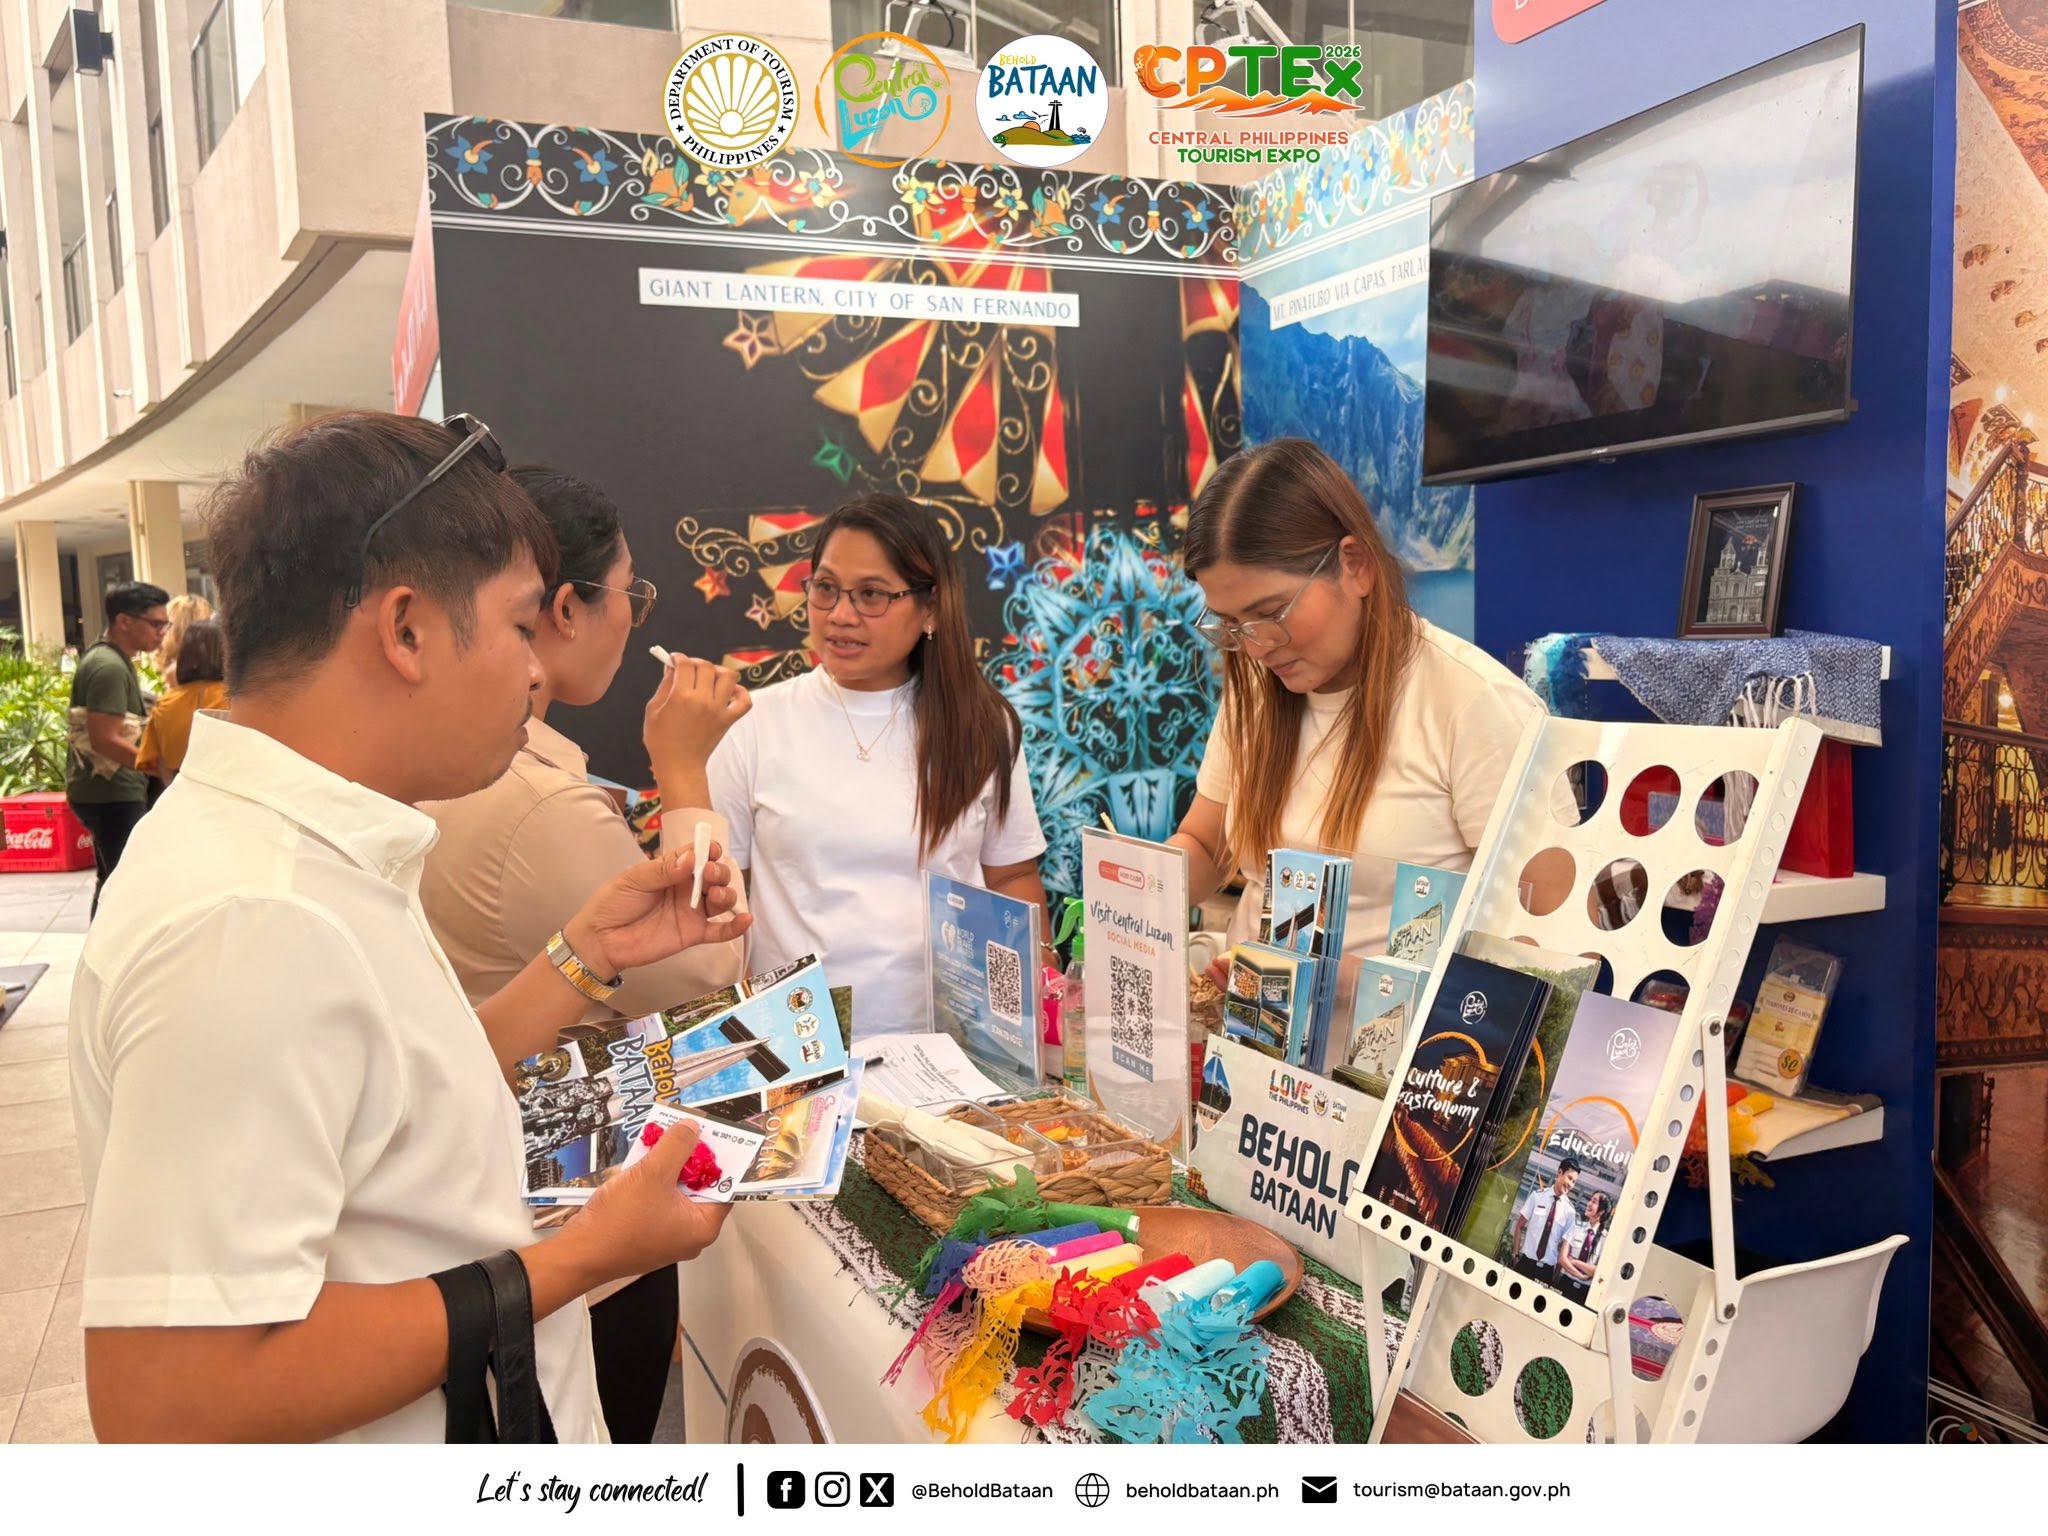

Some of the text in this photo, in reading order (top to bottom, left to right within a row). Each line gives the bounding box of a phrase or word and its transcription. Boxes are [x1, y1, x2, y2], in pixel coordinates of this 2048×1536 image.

[650, 279, 1071, 320] GIANT LANTERN, CITY OF SAN FERNANDO
[1335, 281, 1350, 302] VIA
[1090, 900, 1174, 951] Visit Central Luzon
[1107, 931, 1156, 957] SOCIAL MEDIA
[642, 1036, 681, 1105] BEHOL
[1114, 1051, 1150, 1076] SCAN ME
[1269, 1069, 1312, 1105] LOVE
[1407, 1067, 1480, 1098] Culture &
[1269, 1091, 1278, 1102] THE
[1279, 1095, 1309, 1115] PHILIPPINES
[1238, 1113, 1361, 1207] BEHOLD
[1250, 1169, 1337, 1239] BATAAN
